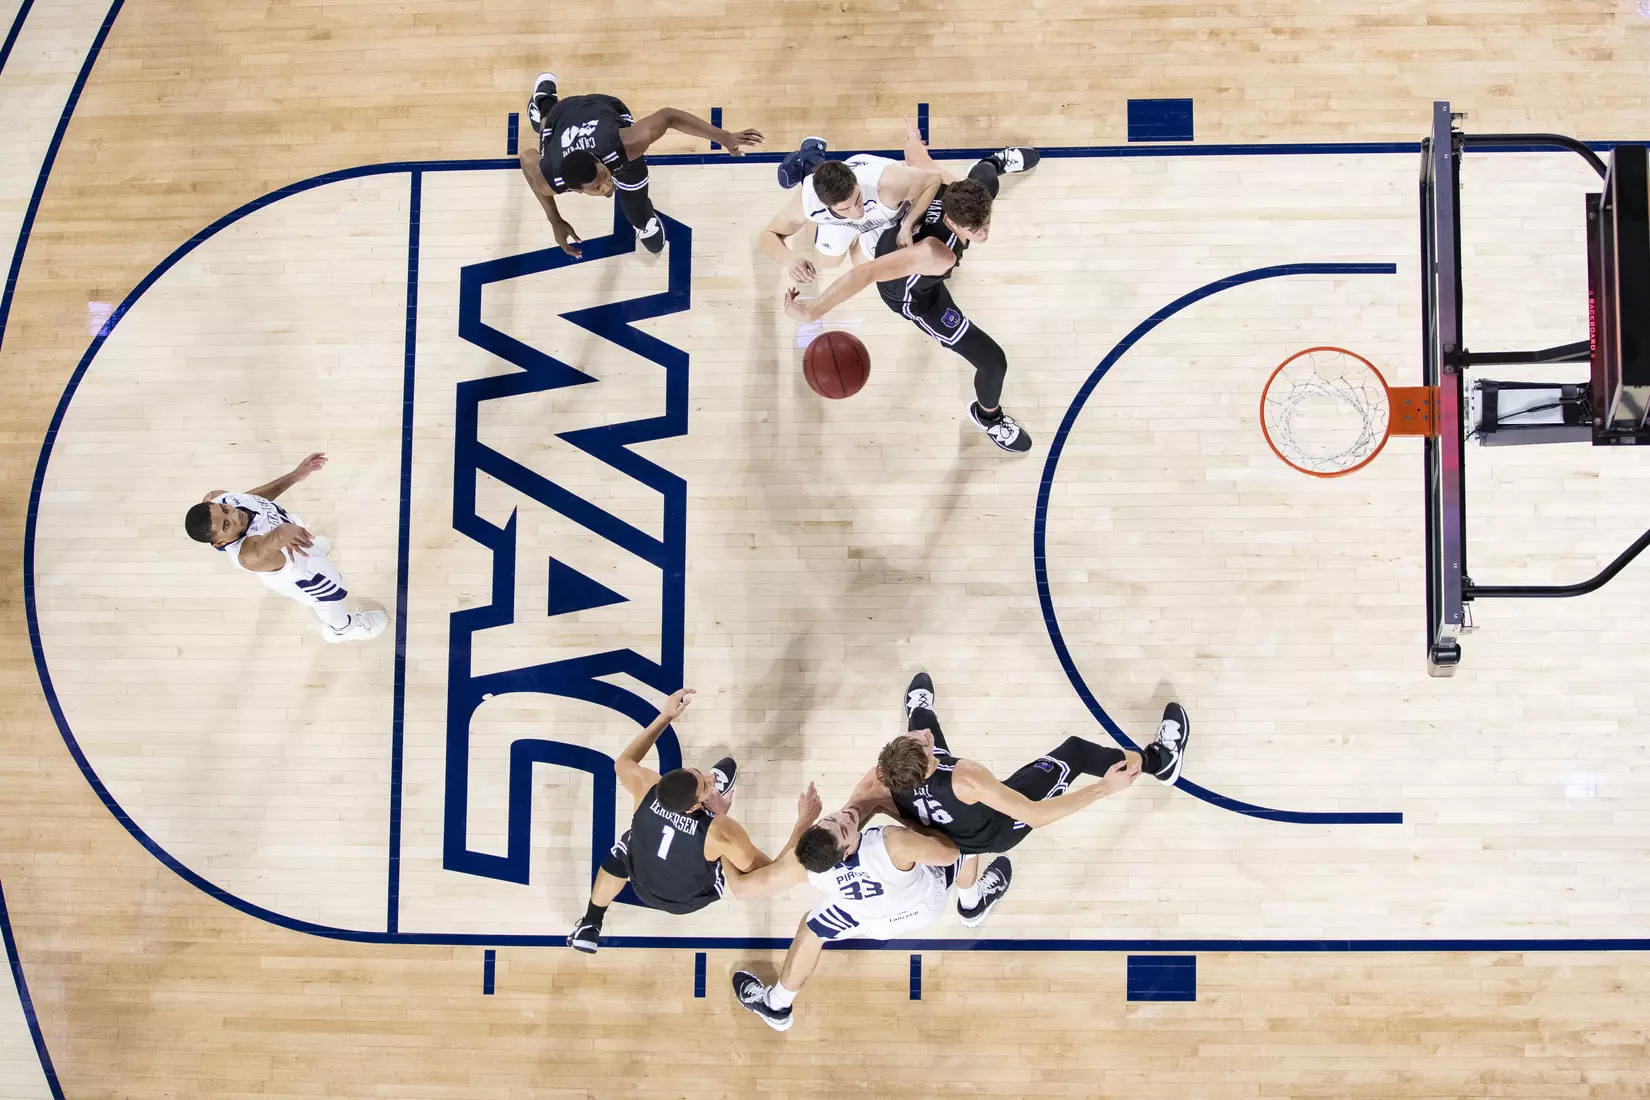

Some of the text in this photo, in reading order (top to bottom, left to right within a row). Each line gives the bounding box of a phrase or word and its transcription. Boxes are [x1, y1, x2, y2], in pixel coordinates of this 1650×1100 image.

[1588, 298, 1596, 351] BACKBOARD
[442, 188, 692, 910] WAC
[657, 824, 676, 860] 1
[839, 878, 885, 901] 33
